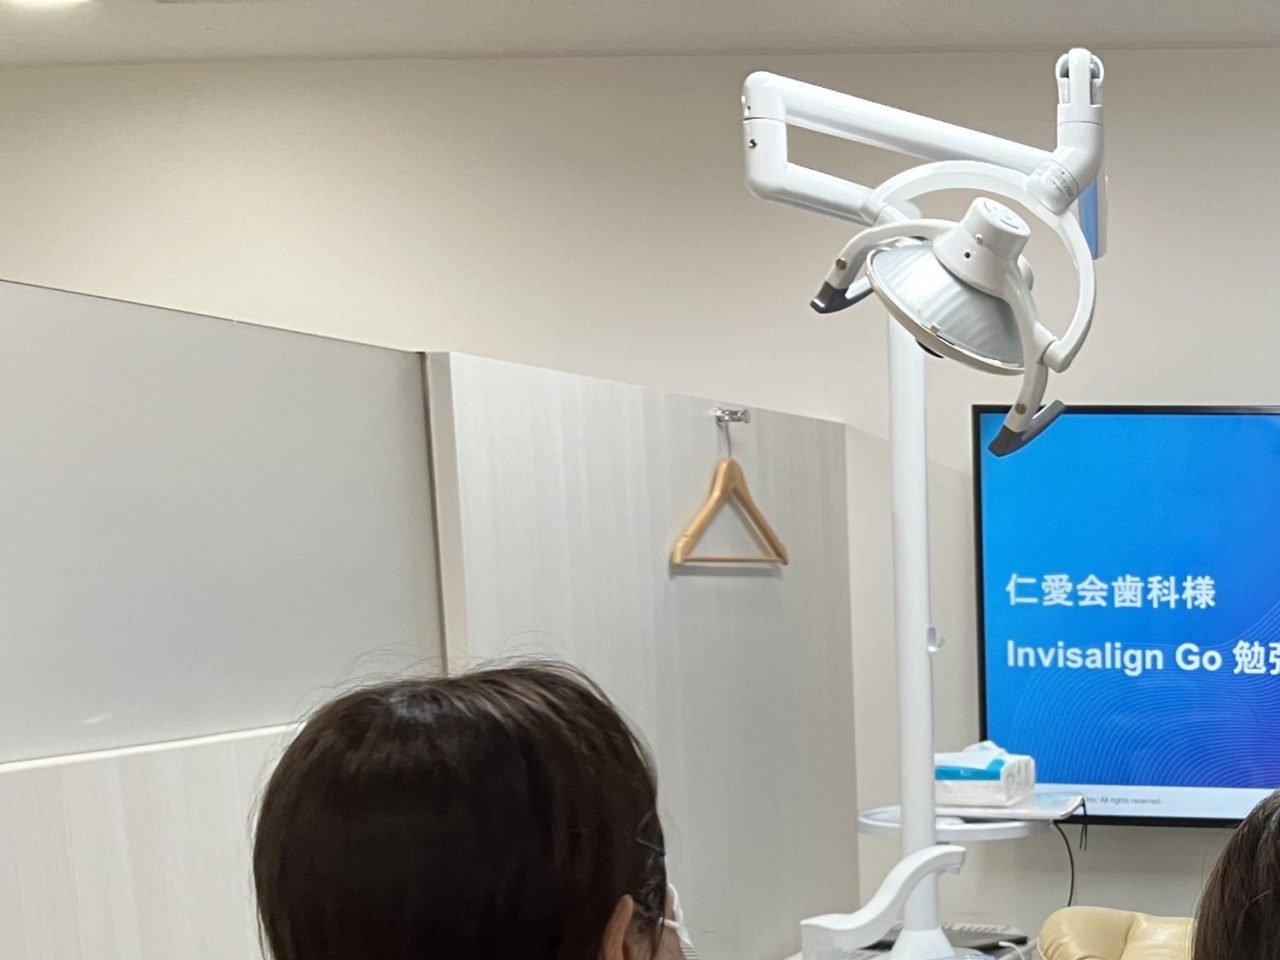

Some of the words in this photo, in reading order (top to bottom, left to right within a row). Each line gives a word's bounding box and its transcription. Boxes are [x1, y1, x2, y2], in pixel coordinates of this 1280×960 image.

[1005, 573, 1217, 609] 仁愛会歯科様
[1007, 639, 1164, 677] Invisalign
[1174, 642, 1223, 671] Go
